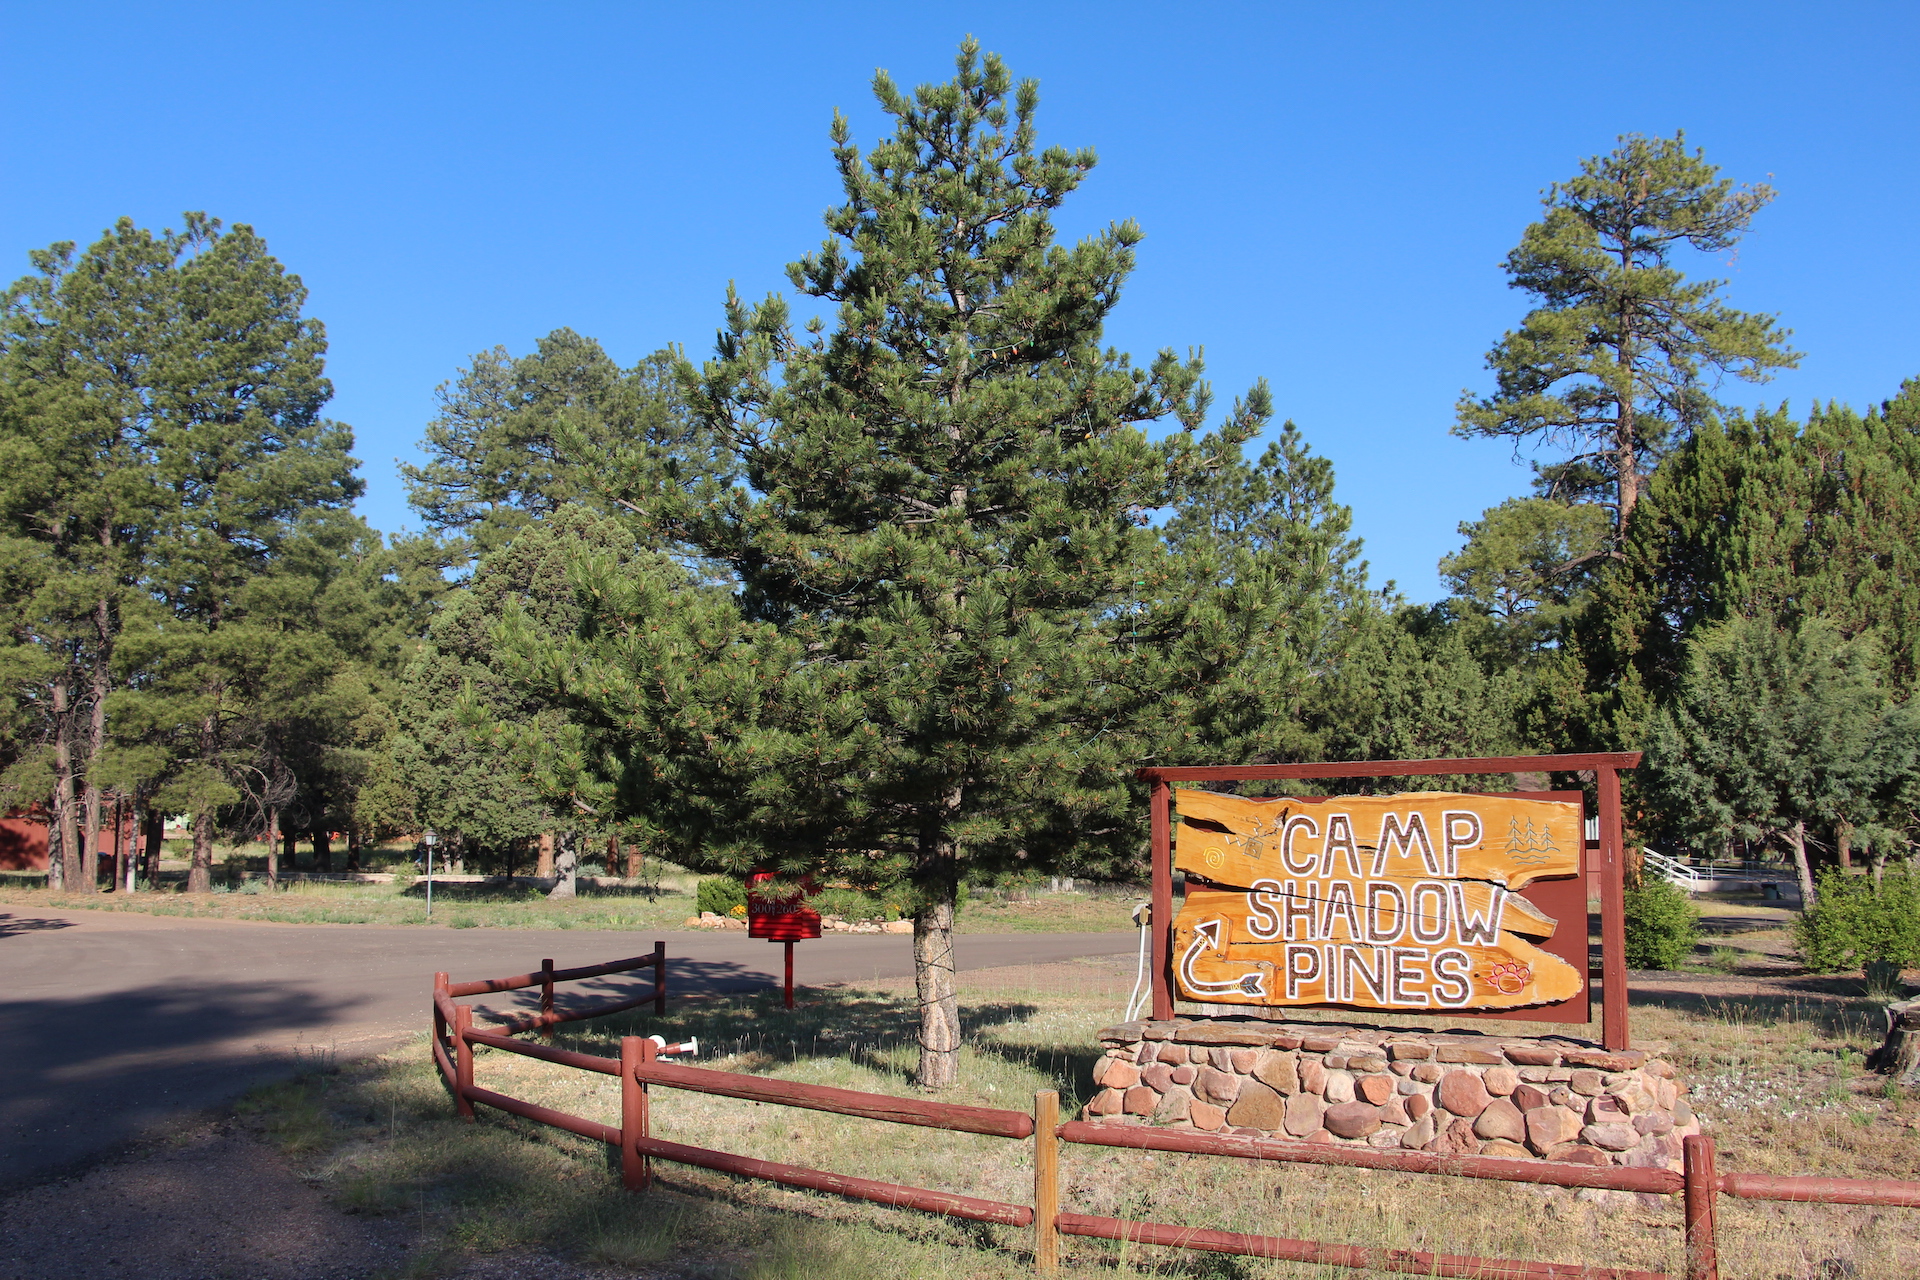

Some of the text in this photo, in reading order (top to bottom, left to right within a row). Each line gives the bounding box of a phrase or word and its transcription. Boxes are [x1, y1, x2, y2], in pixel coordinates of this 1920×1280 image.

[1281, 810, 1482, 878] CAMP
[1247, 879, 1507, 946] SHADOW
[1286, 944, 1472, 1007] PINES
